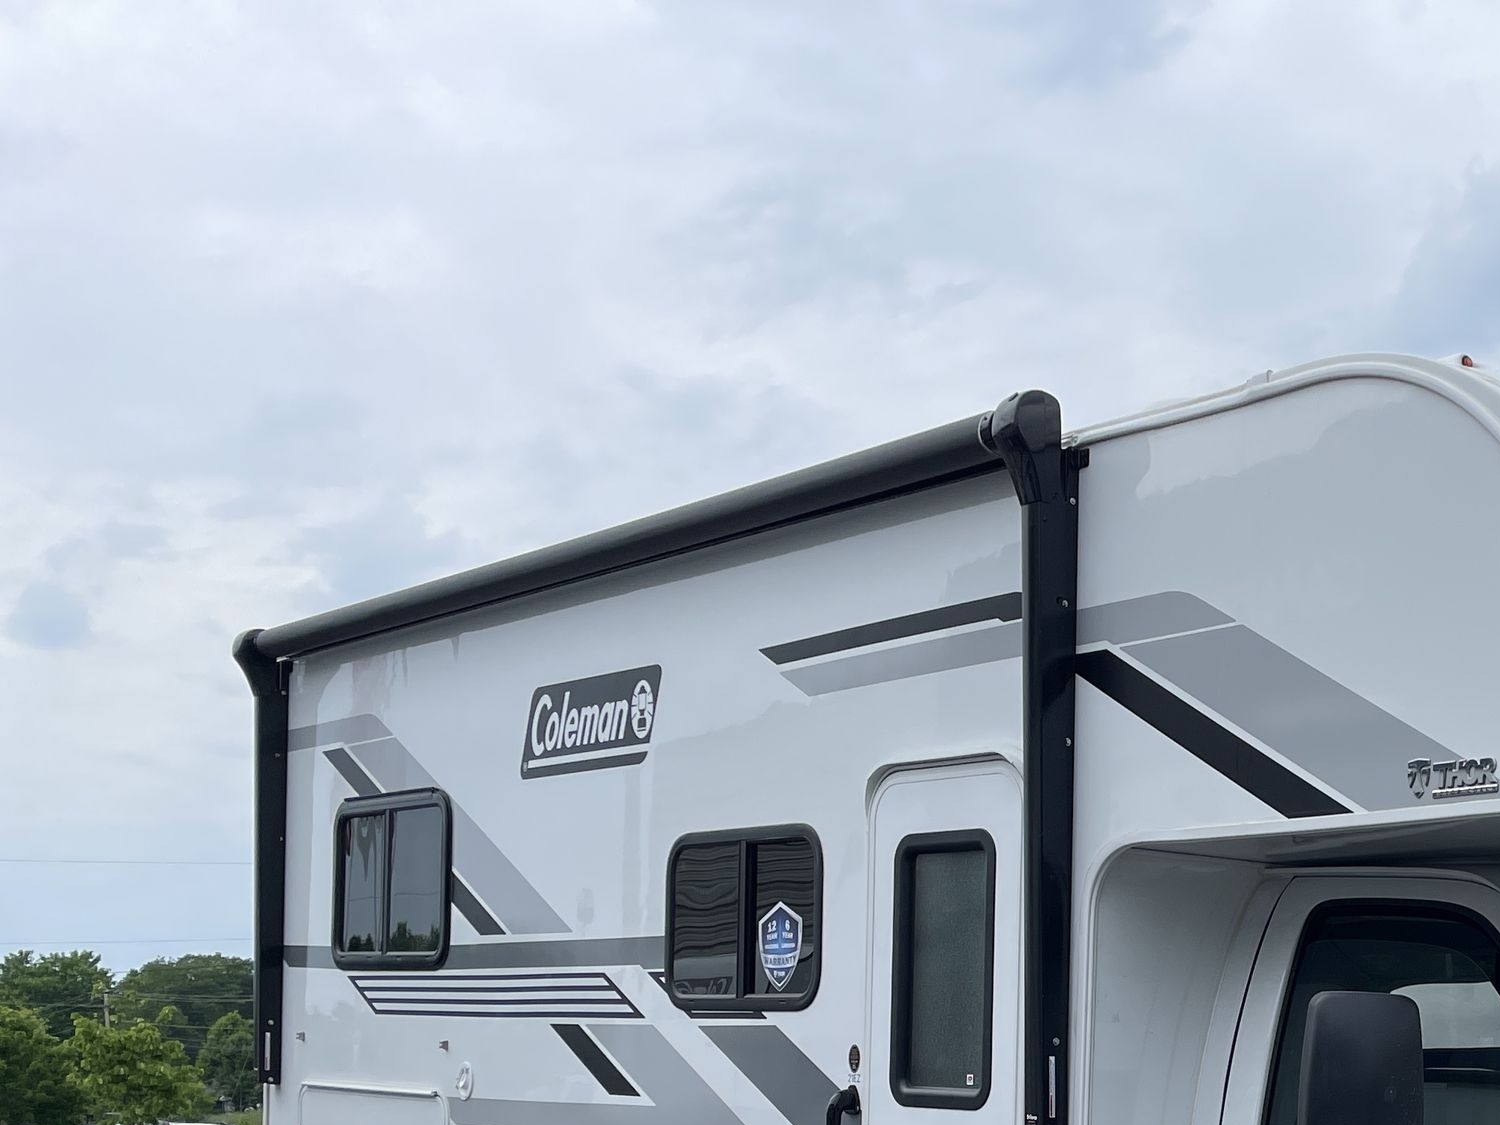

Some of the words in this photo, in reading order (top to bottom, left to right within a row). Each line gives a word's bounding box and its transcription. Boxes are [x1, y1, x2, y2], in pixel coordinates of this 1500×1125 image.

[531, 690, 629, 757] Coleman
[1432, 756, 1498, 790] THOR
[767, 920, 777, 933] 12
[785, 919, 791, 931] 6
[763, 955, 797, 965] WARRANTY
